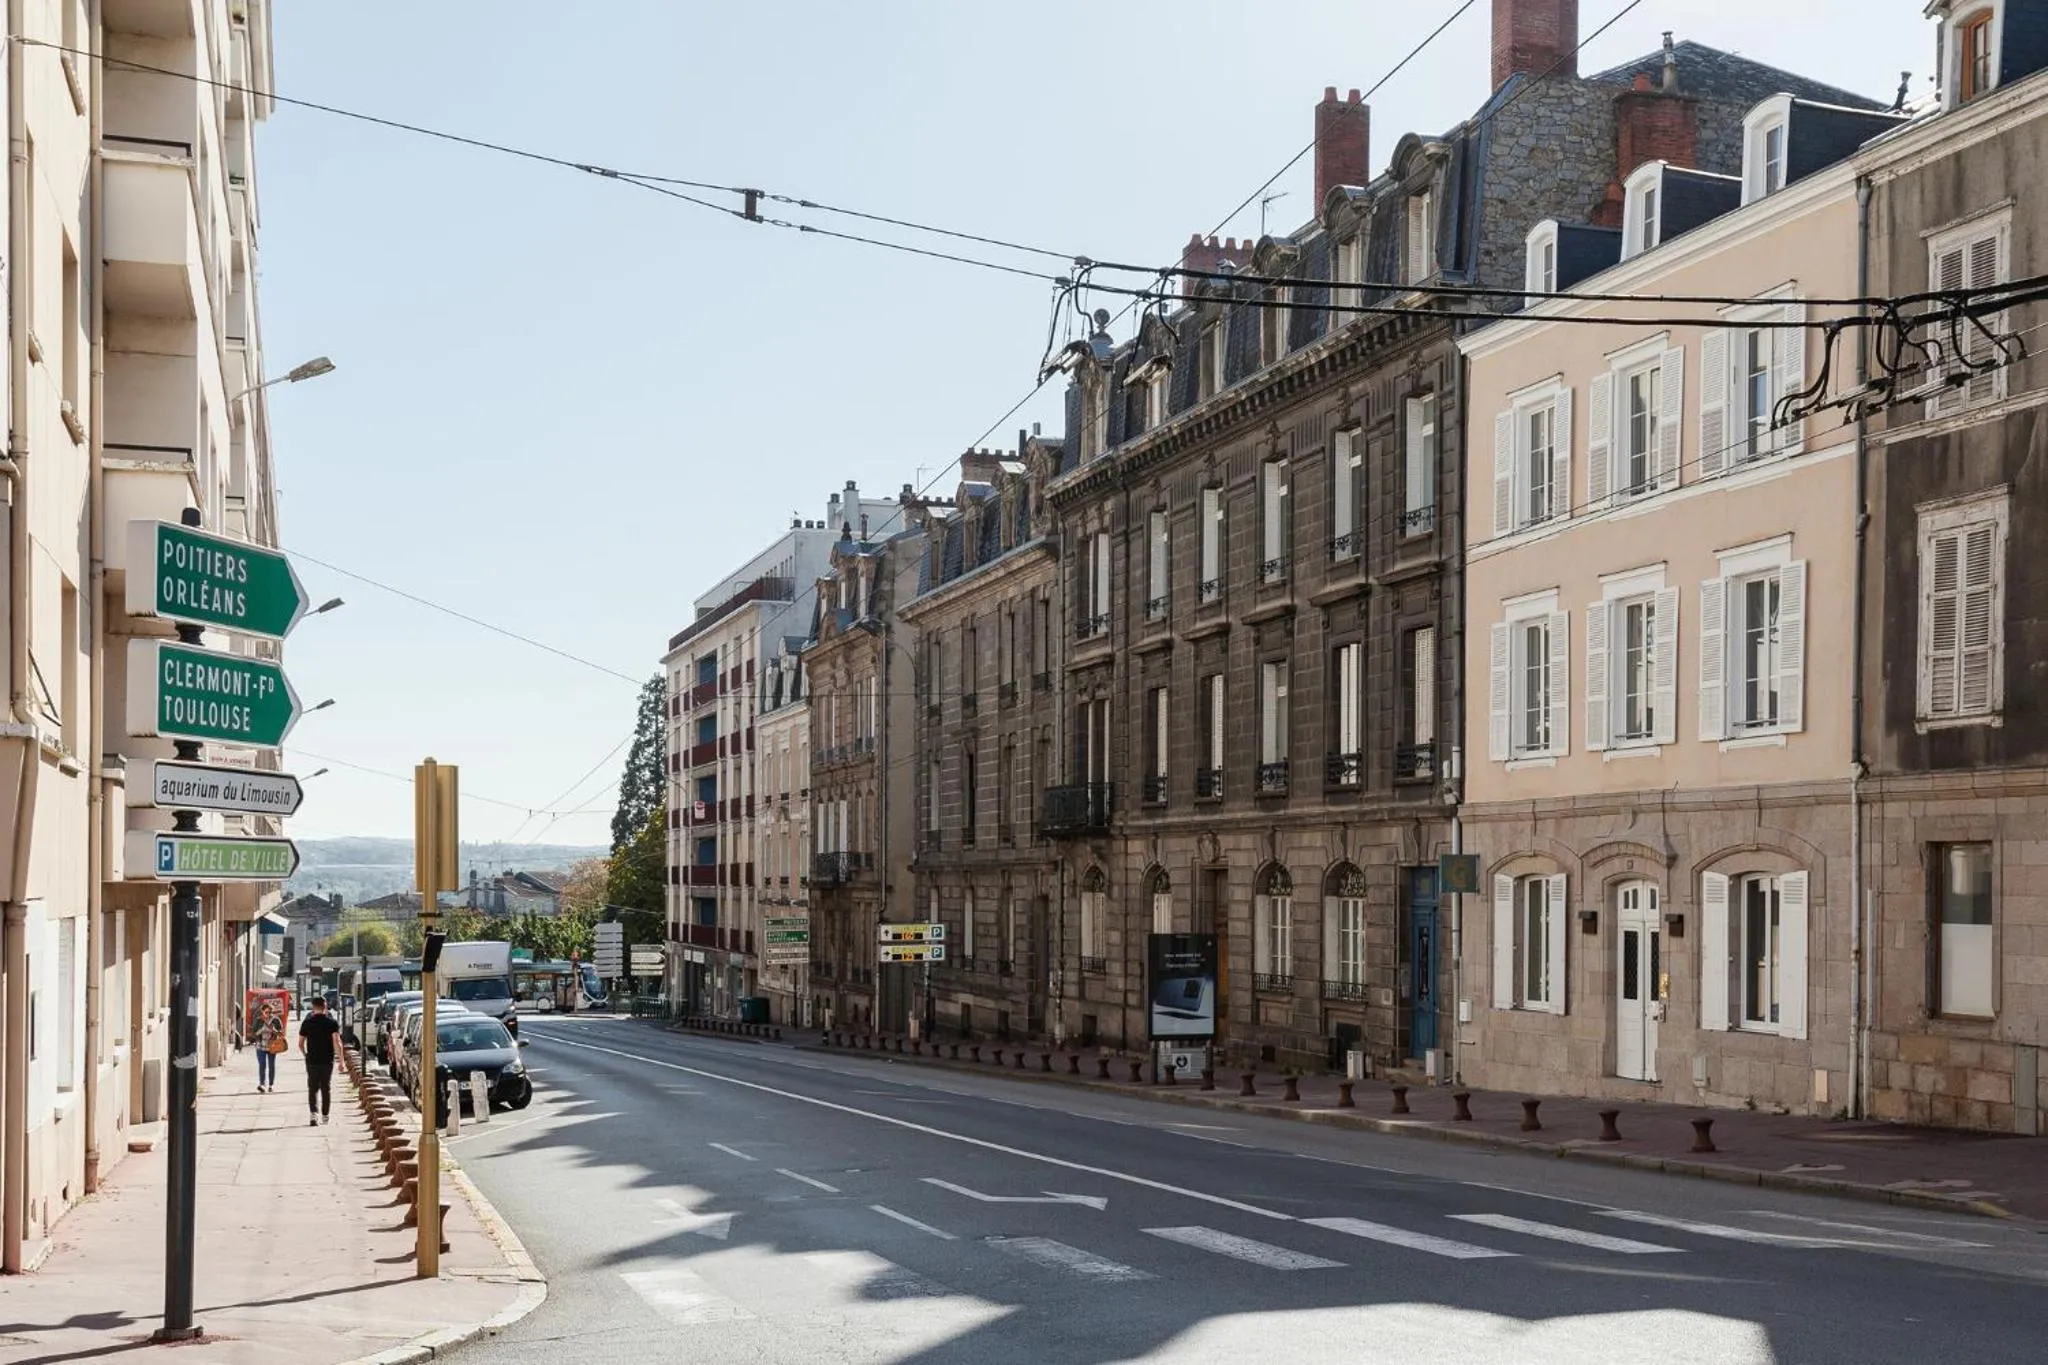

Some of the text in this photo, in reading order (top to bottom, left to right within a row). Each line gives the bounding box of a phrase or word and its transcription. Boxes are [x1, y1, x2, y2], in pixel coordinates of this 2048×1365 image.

[163, 539, 247, 584] POITIERS
[163, 576, 246, 617] ORLÉANS
[164, 695, 251, 732] TOULOUSE
[161, 777, 291, 806] aquarium du Limousin
[161, 844, 288, 872] P HÔTEL DE VILLE
